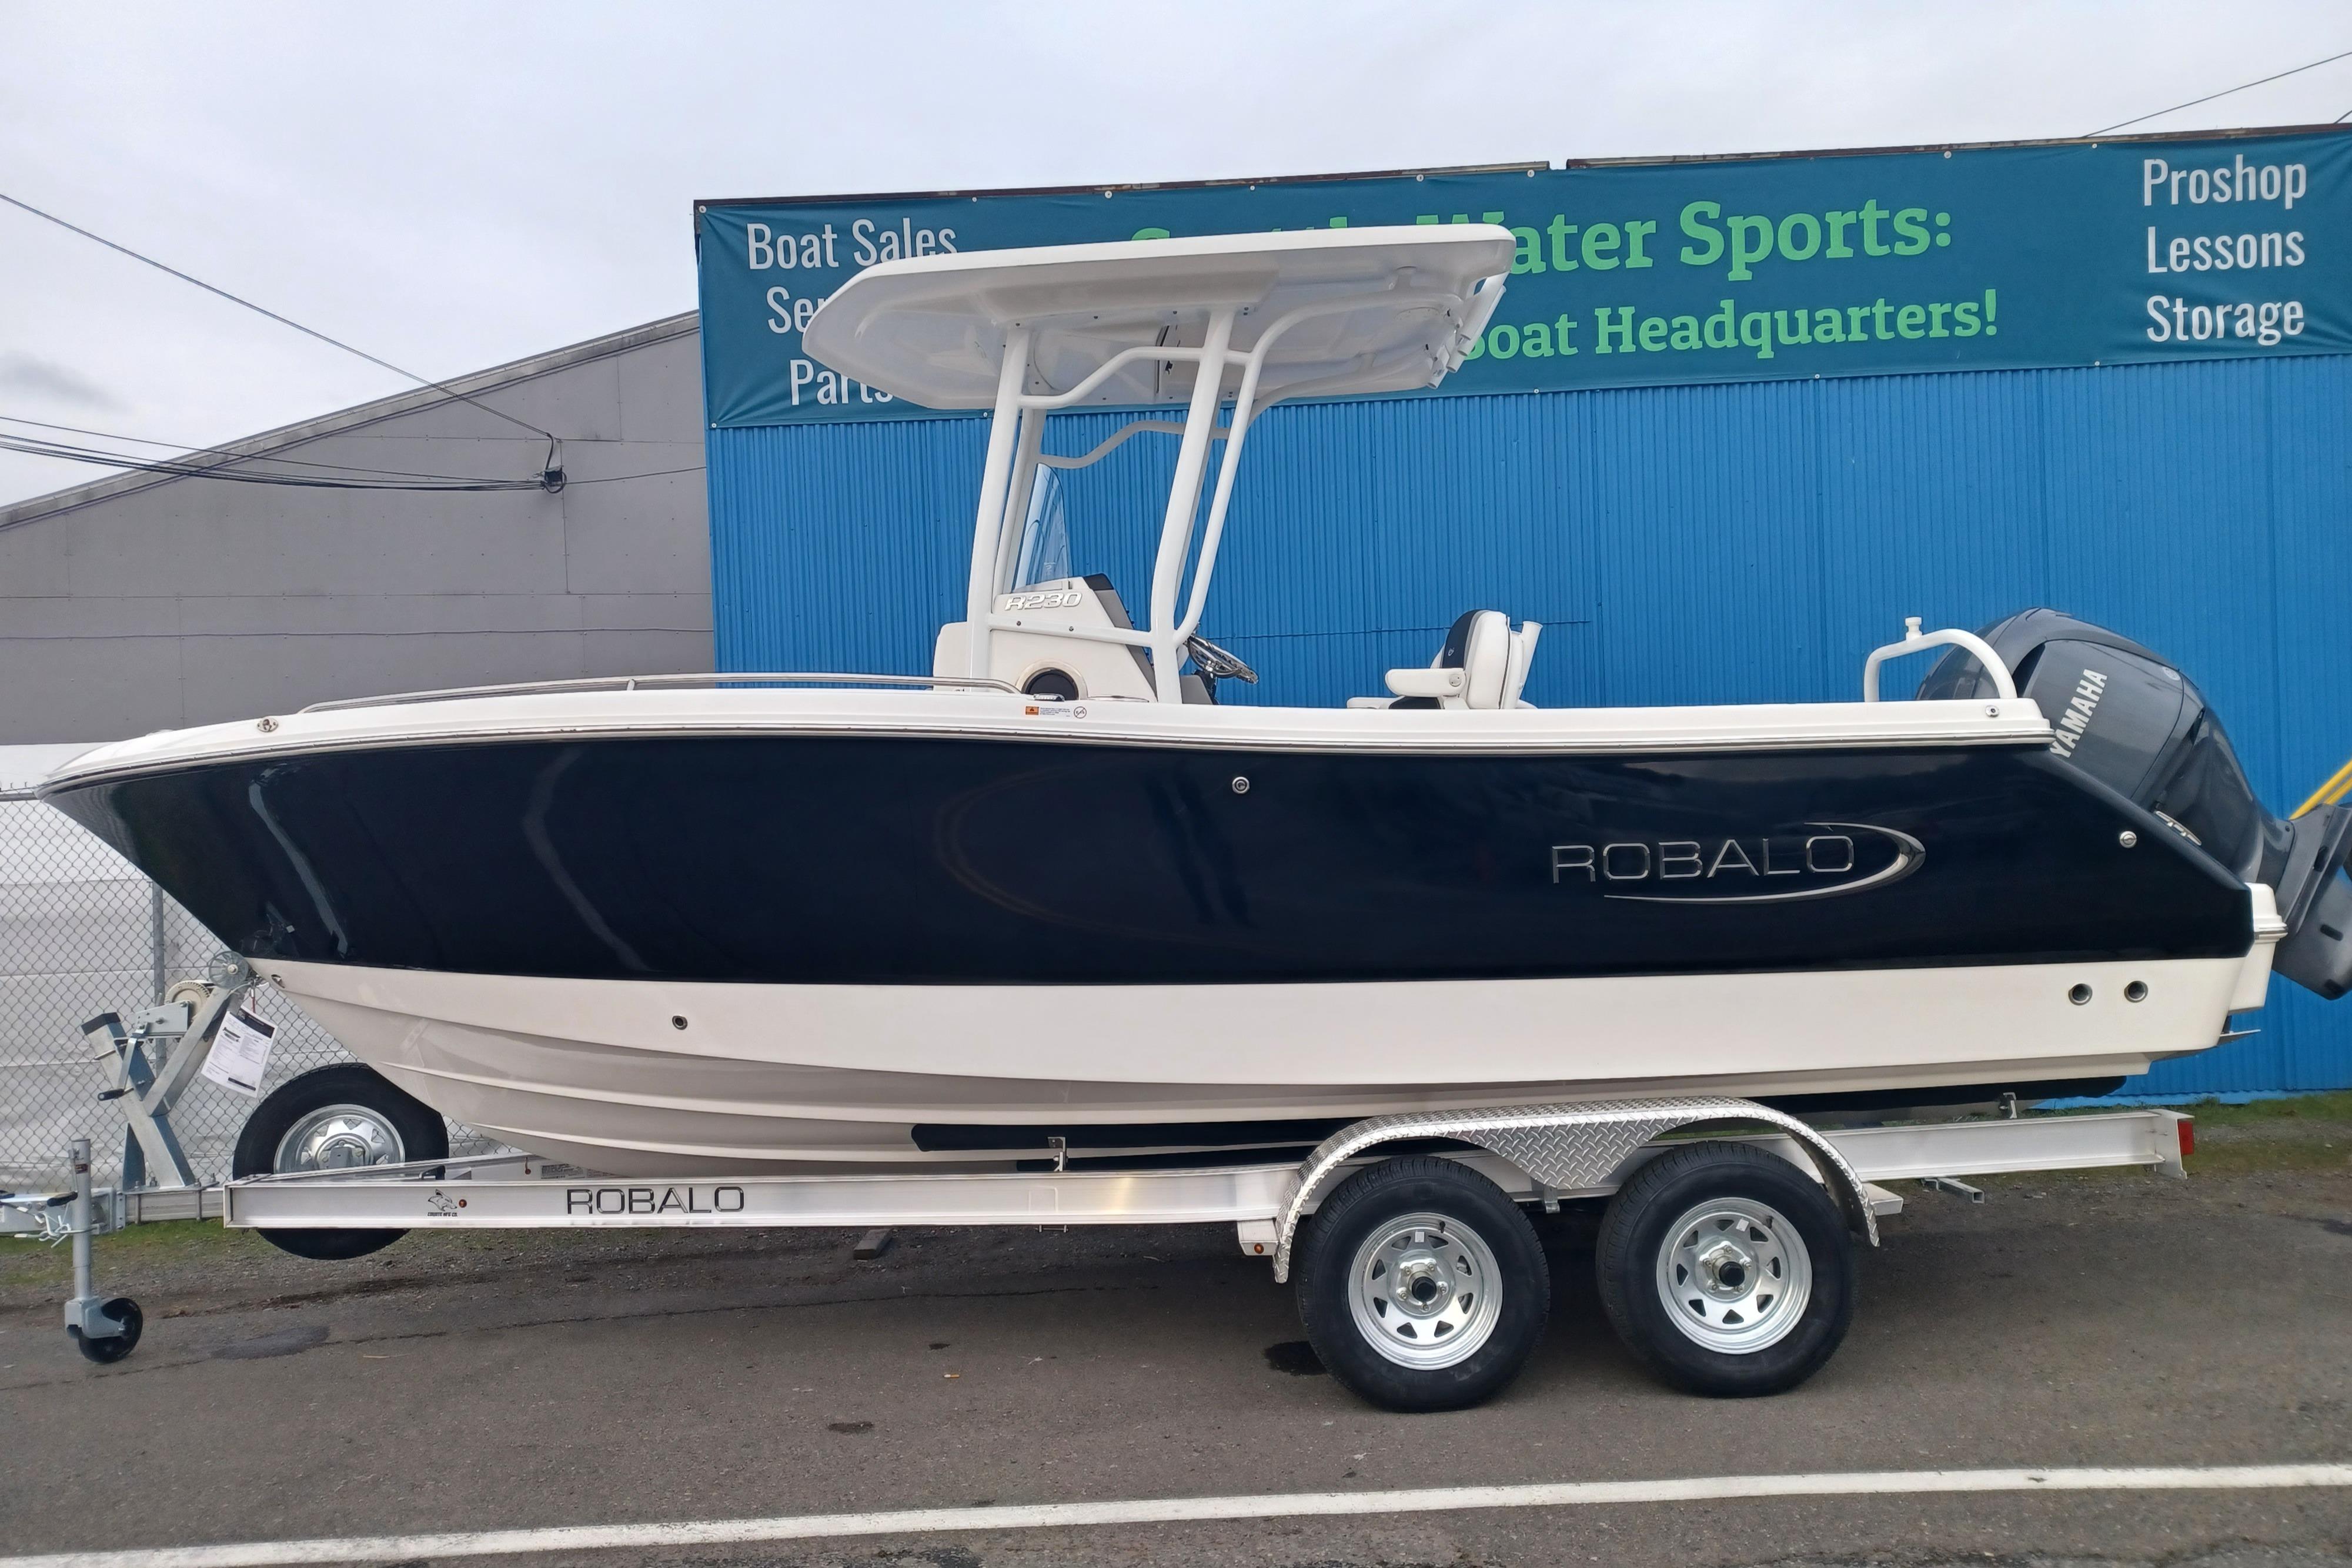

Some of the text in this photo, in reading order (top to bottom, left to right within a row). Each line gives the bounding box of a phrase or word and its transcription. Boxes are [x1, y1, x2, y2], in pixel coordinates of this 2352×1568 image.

[2144, 154, 2307, 209] Proshop
[747, 217, 958, 270] Boat Sales
[1416, 199, 1951, 281] ater Sports:
[2147, 226, 2306, 273] Lessons
[766, 286, 828, 334] Se
[1594, 289, 1997, 359] Headquarters!
[2146, 295, 2305, 346] Storage
[1004, 592, 1083, 611] R230
[2050, 669, 2108, 758] YAMAHA
[1552, 835, 1854, 884] ROBALO
[567, 1186, 744, 1215] ROBALO
